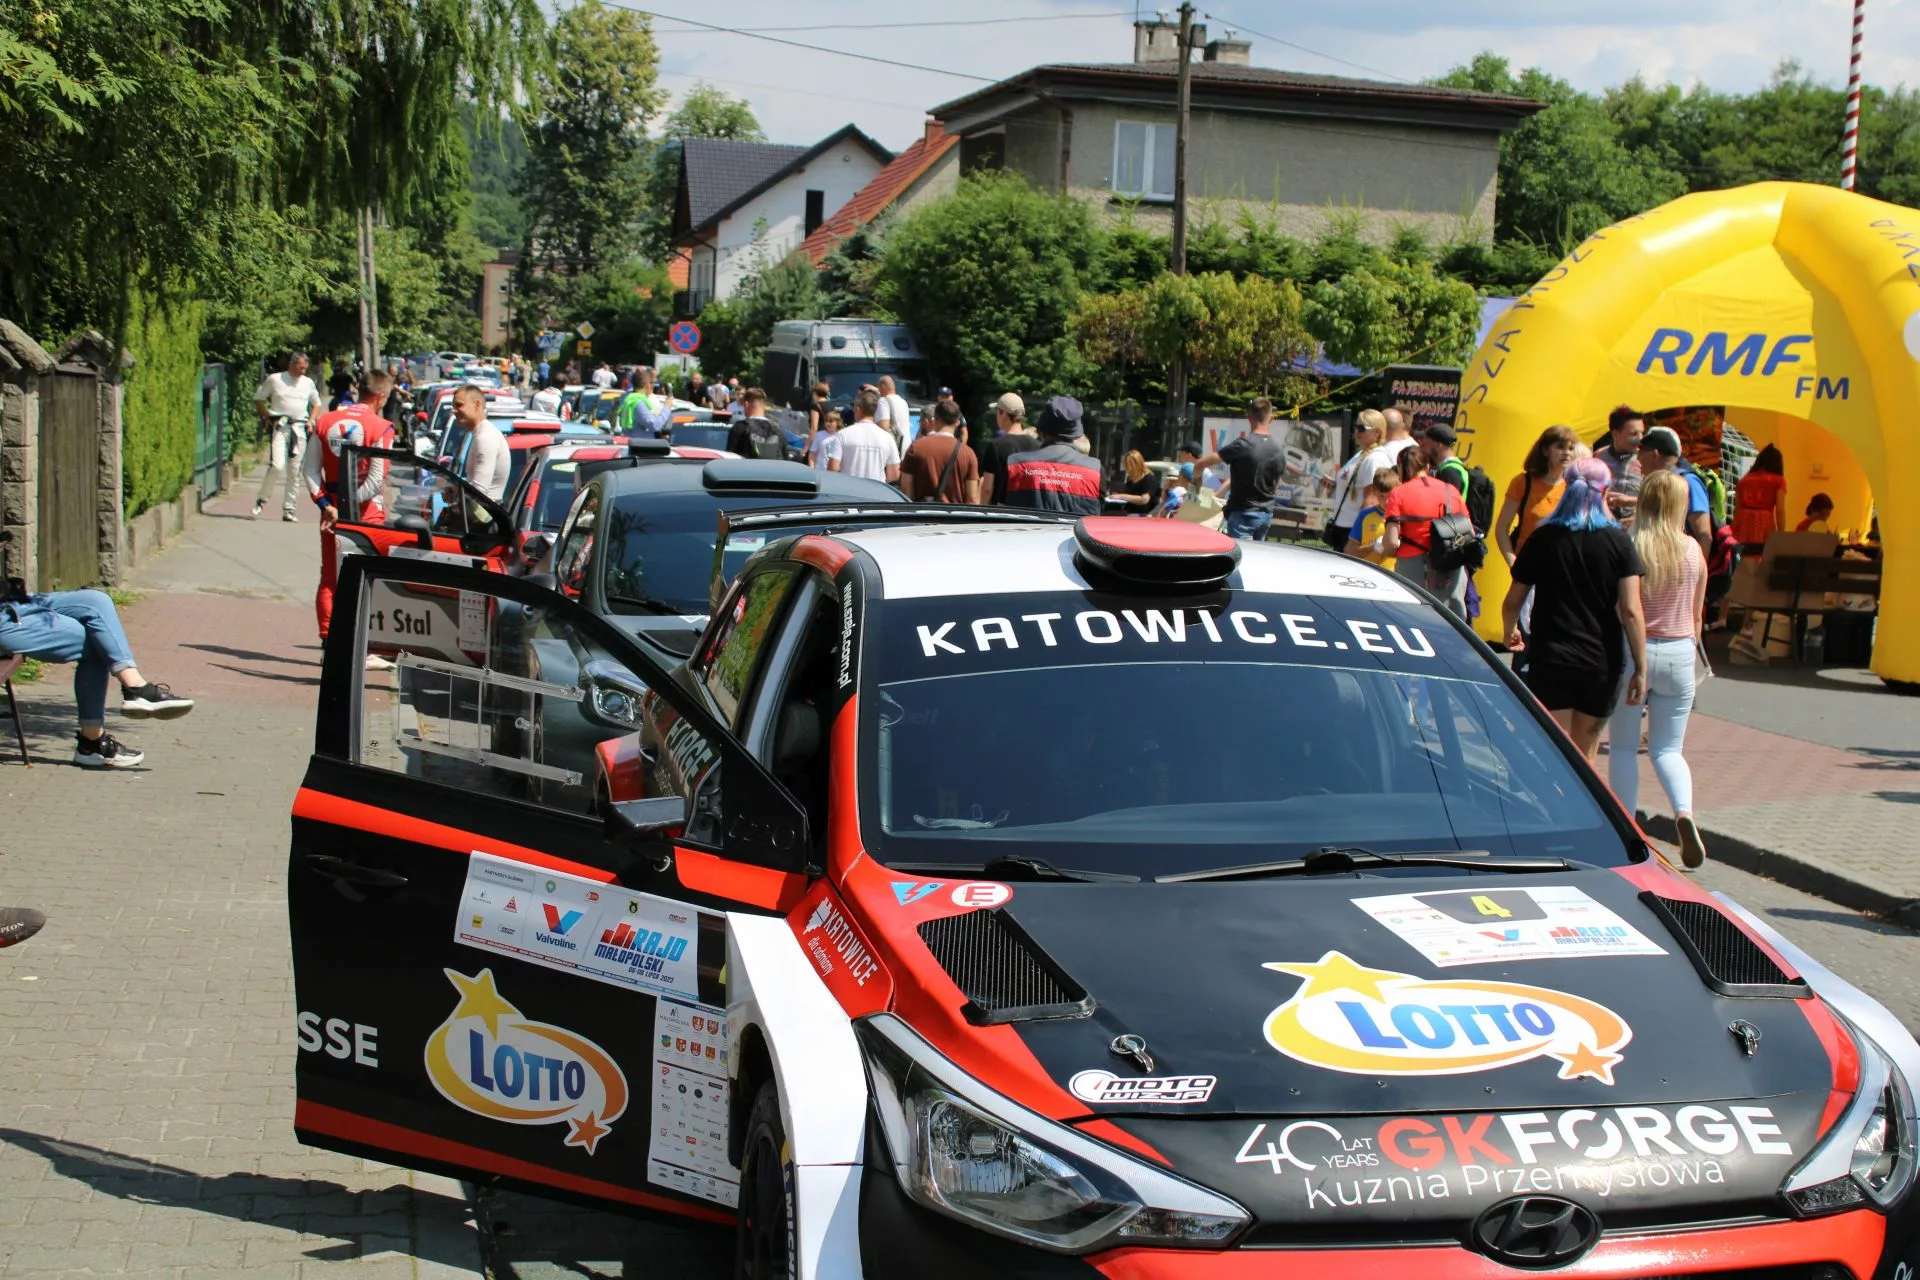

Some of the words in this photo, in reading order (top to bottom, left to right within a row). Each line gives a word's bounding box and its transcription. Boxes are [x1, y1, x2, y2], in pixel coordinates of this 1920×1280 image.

[1635, 328, 1814, 376] RMF
[1391, 380, 1460, 399] FAJERWERKI
[1795, 377, 1850, 401] FM
[368, 610, 385, 631] rt
[392, 608, 432, 636] Stal
[837, 581, 856, 690] www.szeja.com.pl
[916, 609, 1437, 658] KATOWICE.EU
[965, 886, 996, 902] E
[1470, 896, 1512, 917] 4
[535, 931, 578, 951] Valvoline
[630, 927, 688, 963] RAJD
[823, 908, 878, 987] KATOWICE
[594, 943, 665, 974] MAŁOPOLSKI
[298, 1011, 379, 1068] SSE
[1334, 1000, 1556, 1050] LOTTO
[468, 1028, 586, 1101] LOTTO
[1100, 1089, 1209, 1101] WIZJA
[1106, 1078, 1214, 1091] MOTO
[1235, 1120, 1343, 1175] 40
[1341, 1138, 1373, 1151] LAT
[1321, 1153, 1380, 1169] YEARS
